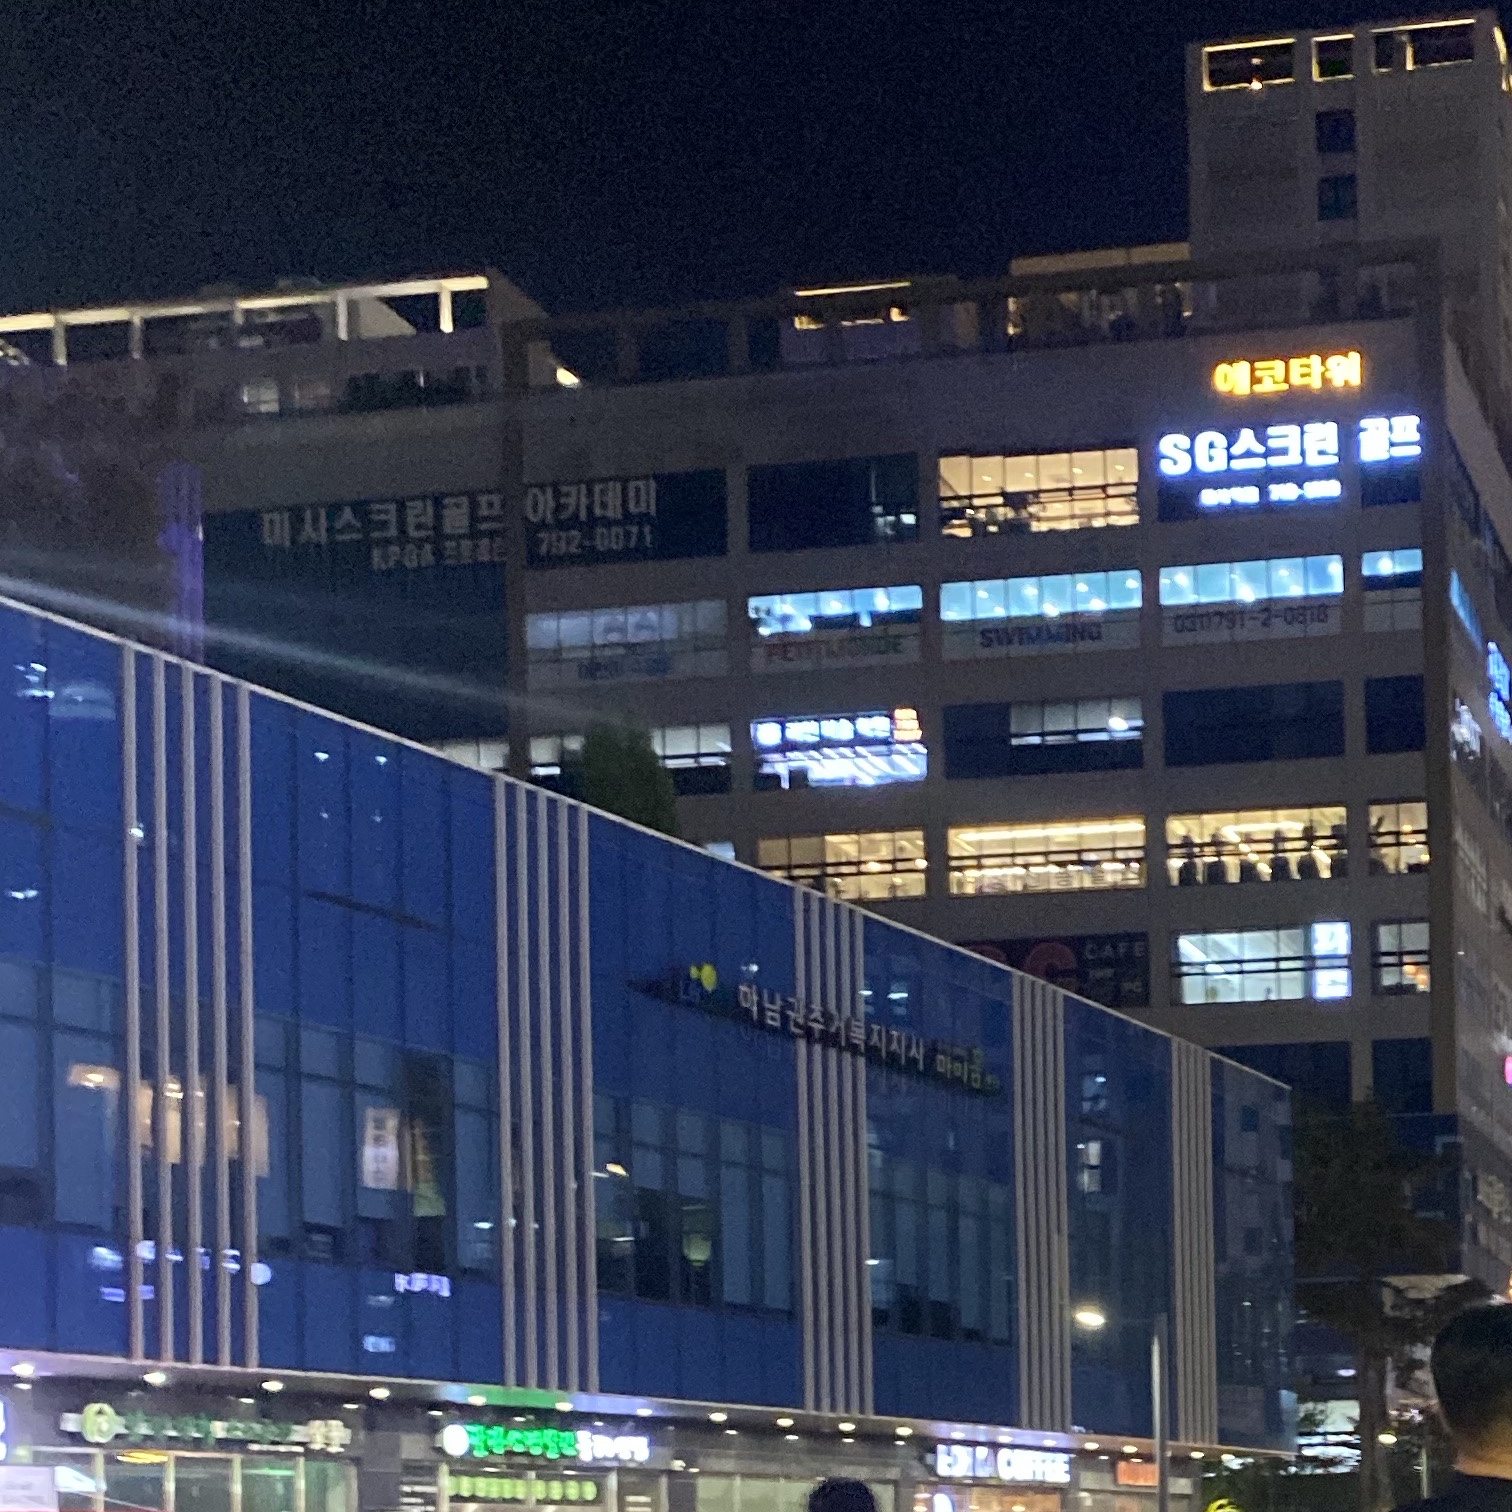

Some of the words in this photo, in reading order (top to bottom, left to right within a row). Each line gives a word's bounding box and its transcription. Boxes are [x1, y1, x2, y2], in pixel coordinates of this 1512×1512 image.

[1212, 351, 1362, 396] 에코타워
[1158, 421, 1341, 476] SG스크린
[1358, 414, 1422, 463] 골프
[525, 478, 657, 523] 아카데미
[979, 622, 1103, 648] SWIMMING
[1085, 941, 1146, 960] CAFE
